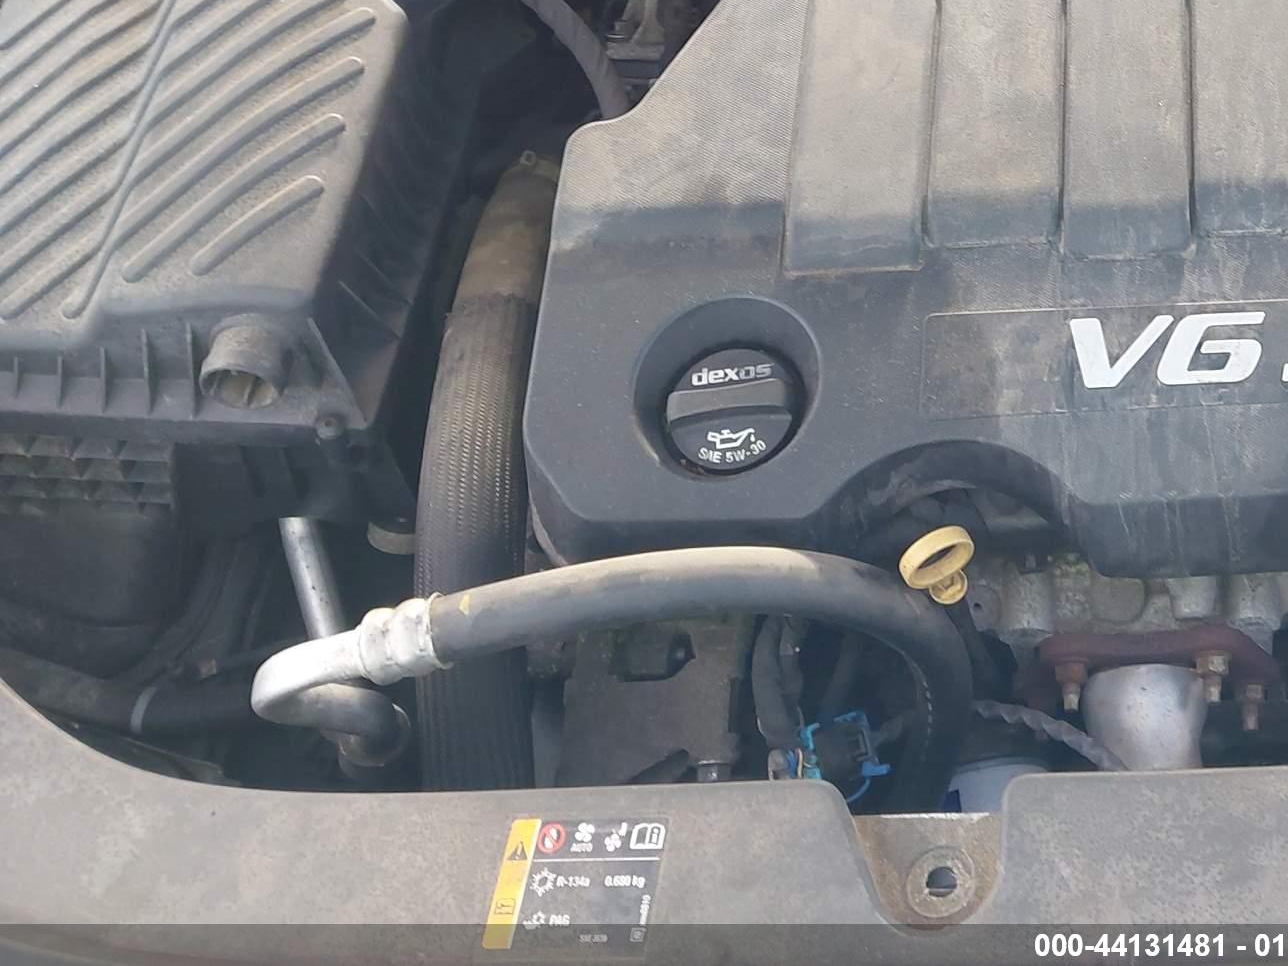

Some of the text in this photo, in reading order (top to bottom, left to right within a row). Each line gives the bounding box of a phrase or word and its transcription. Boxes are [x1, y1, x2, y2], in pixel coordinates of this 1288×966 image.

[1070, 311, 1266, 389] V6
[691, 363, 775, 386] dexos
[698, 440, 767, 463] SAE 5W-30
[570, 842, 593, 852] AUTO
[549, 914, 570, 926] PAG
